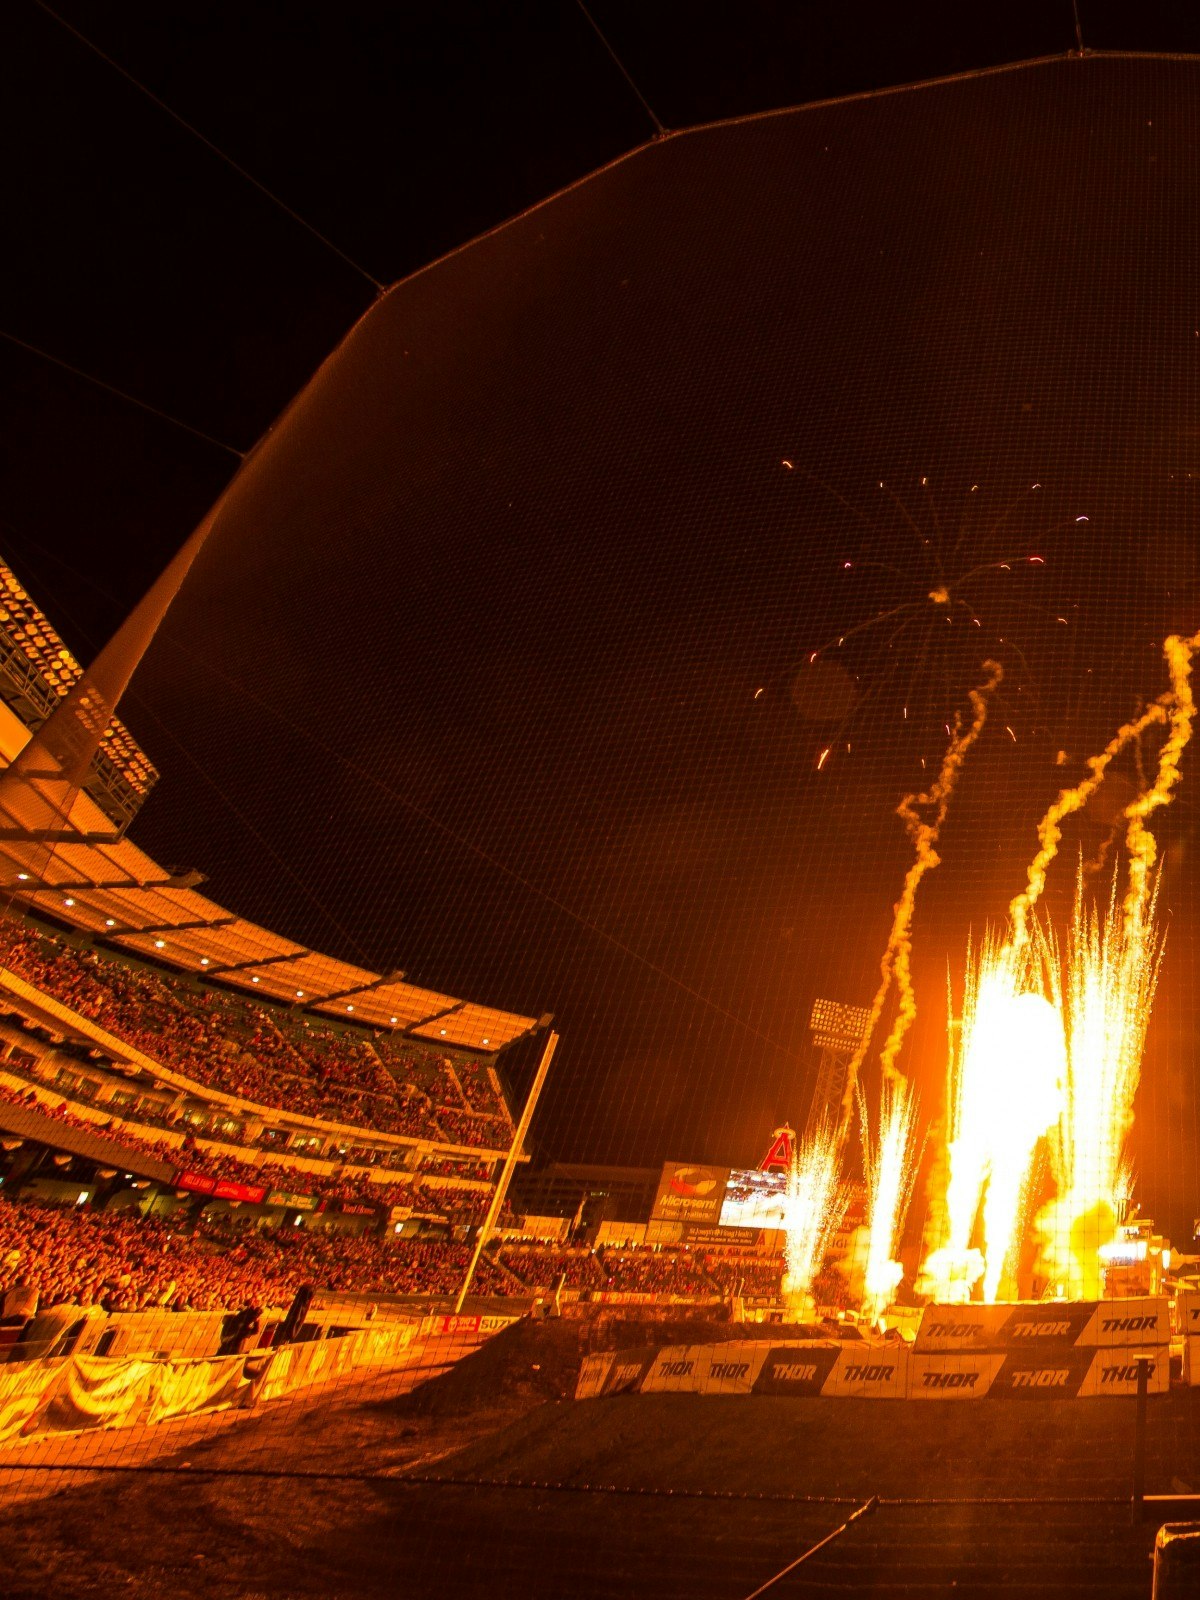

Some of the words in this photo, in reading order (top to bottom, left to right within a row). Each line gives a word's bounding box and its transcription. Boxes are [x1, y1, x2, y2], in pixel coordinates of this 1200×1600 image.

[926, 1322, 985, 1338] THOR
[1012, 1320, 1072, 1337] THOR
[1100, 1315, 1160, 1333] THOR
[615, 1363, 643, 1380] THOR
[659, 1360, 695, 1377] THOR
[710, 1362, 751, 1379] THOR
[772, 1363, 818, 1381] THOR
[843, 1365, 896, 1381] THOR
[922, 1371, 980, 1388] THOR
[1012, 1369, 1070, 1387] THOR
